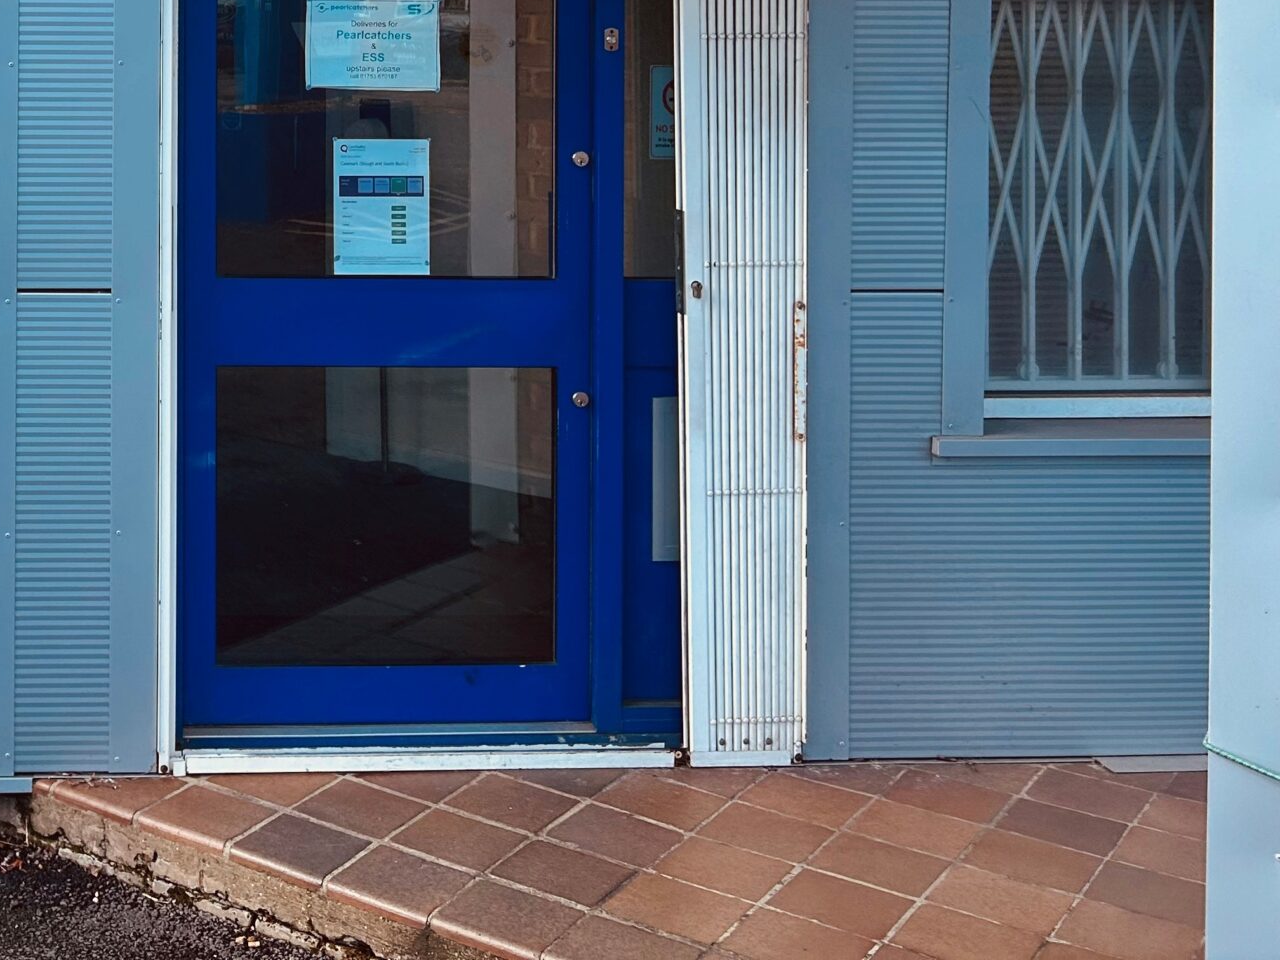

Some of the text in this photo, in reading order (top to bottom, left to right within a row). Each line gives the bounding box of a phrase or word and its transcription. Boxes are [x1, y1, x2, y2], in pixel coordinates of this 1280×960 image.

[351, 20, 398, 28] Deliveries for
[336, 30, 412, 40] Pearlcatchers
[371, 42, 377, 50] &
[362, 52, 385, 62] ESS
